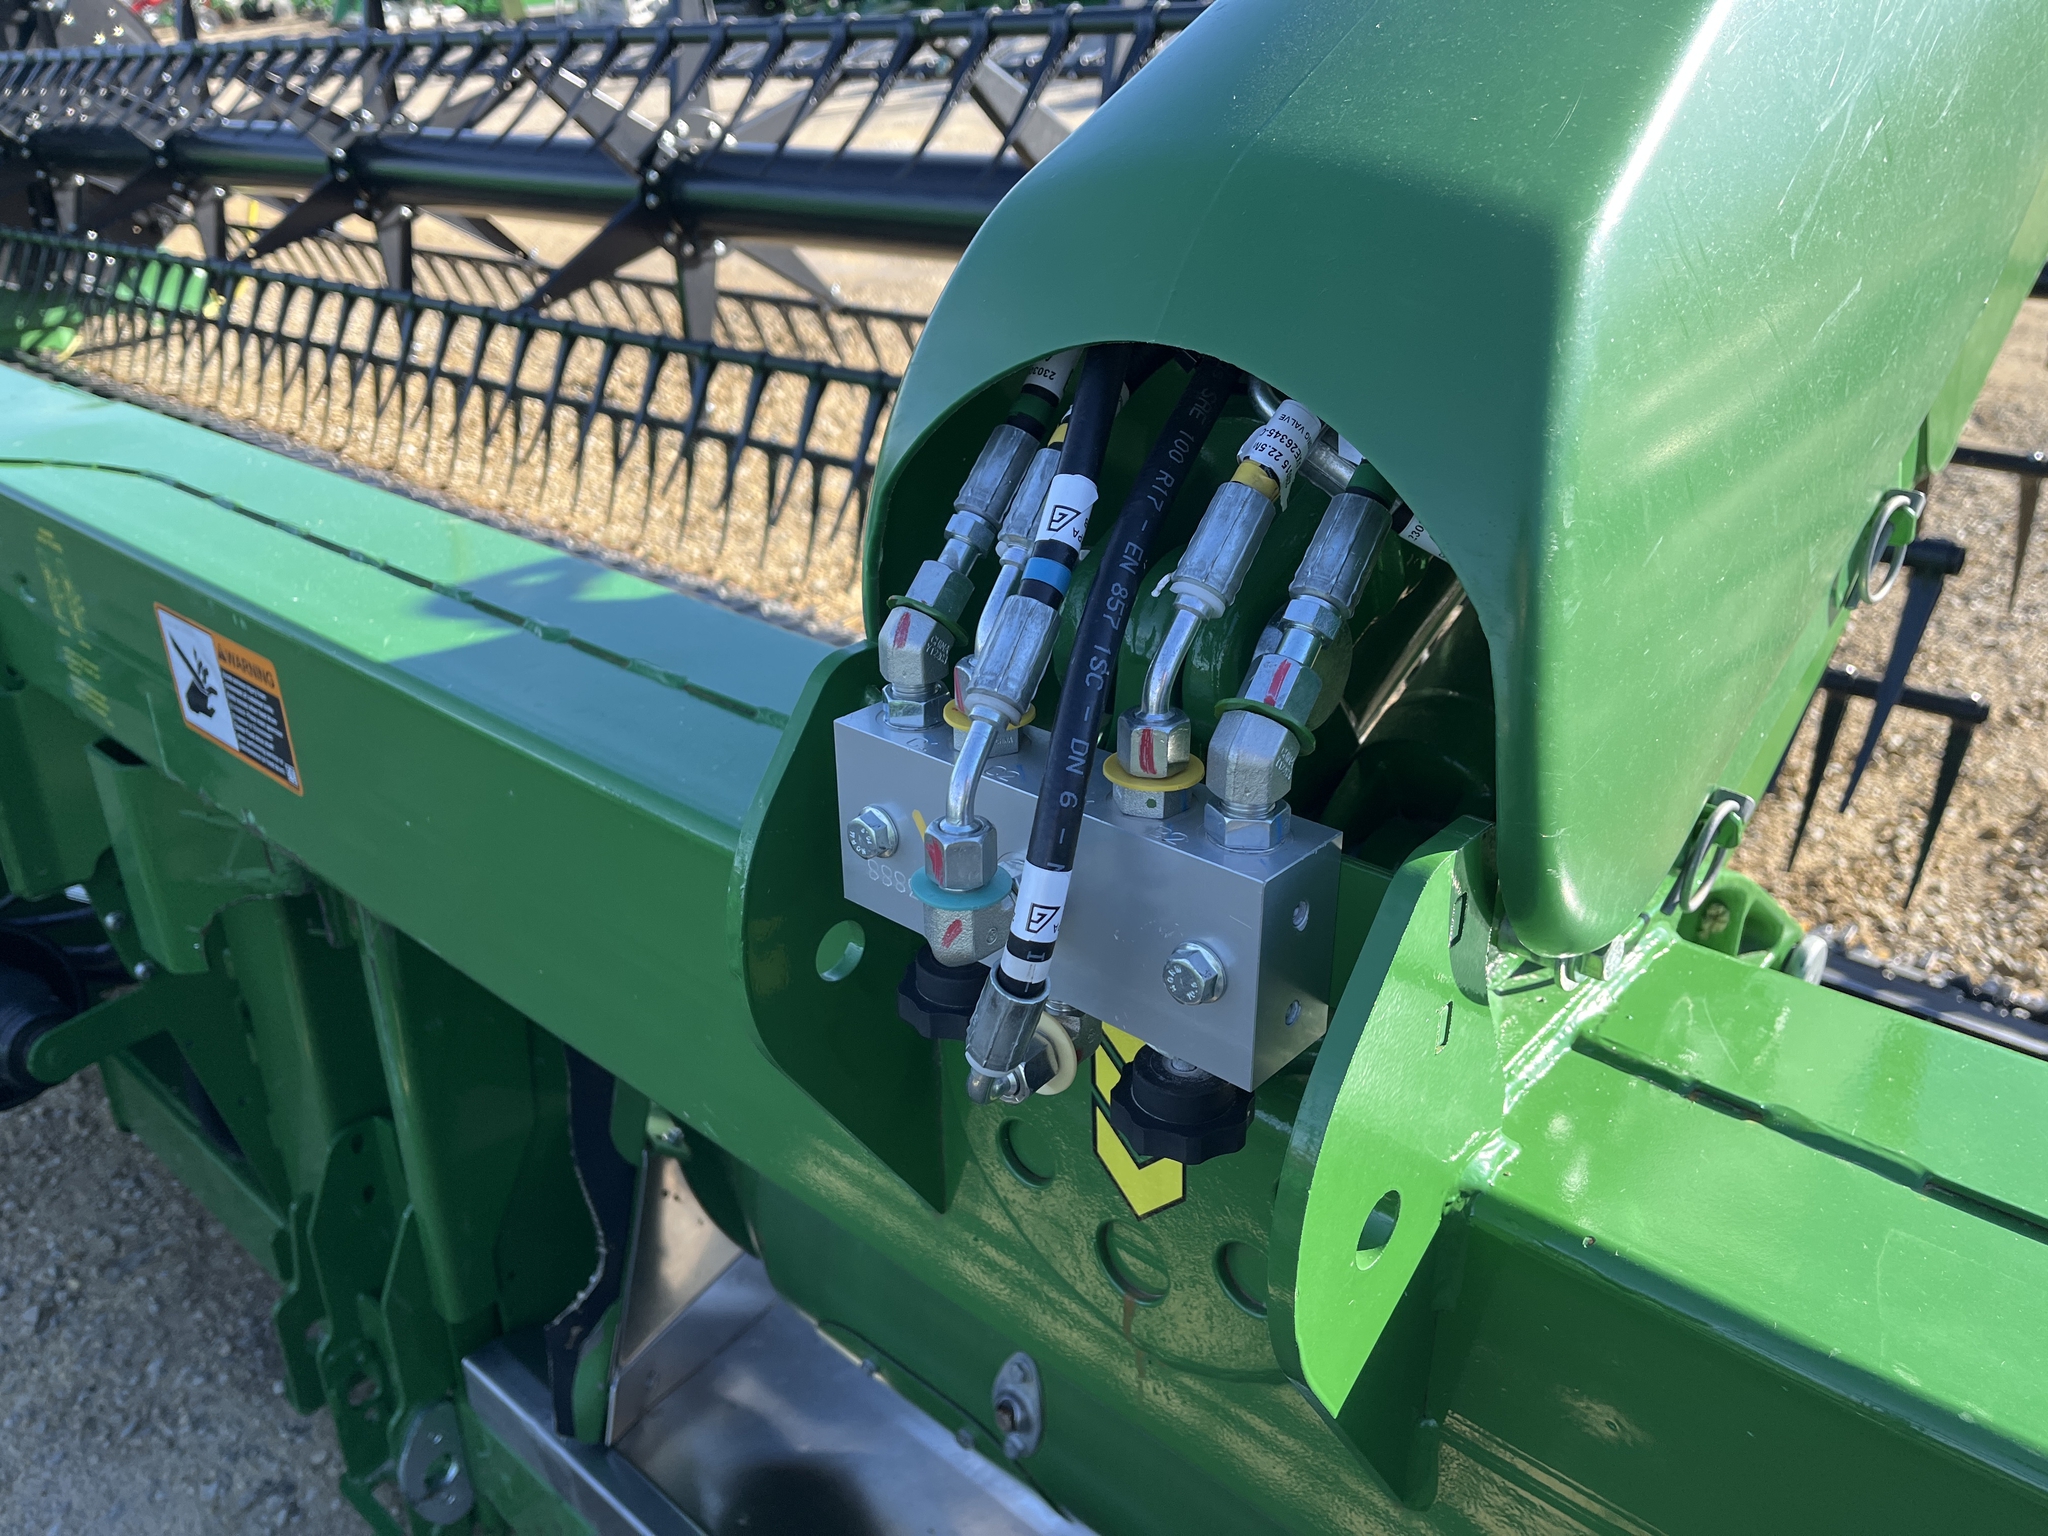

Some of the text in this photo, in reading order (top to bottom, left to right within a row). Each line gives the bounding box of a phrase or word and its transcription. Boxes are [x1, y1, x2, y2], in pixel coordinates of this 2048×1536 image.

[1189, 386, 1217, 426] SAE
[1279, 413, 1305, 435] VALVE
[1168, 429, 1196, 469] 100
[1147, 469, 1175, 512] R17
[1118, 541, 1144, 576] EN
[1102, 584, 1128, 631] 857
[226, 652, 275, 689] WARNING
[1085, 644, 1112, 692] 1SC
[1065, 737, 1090, 776] DN
[1059, 790, 1078, 809] 6
